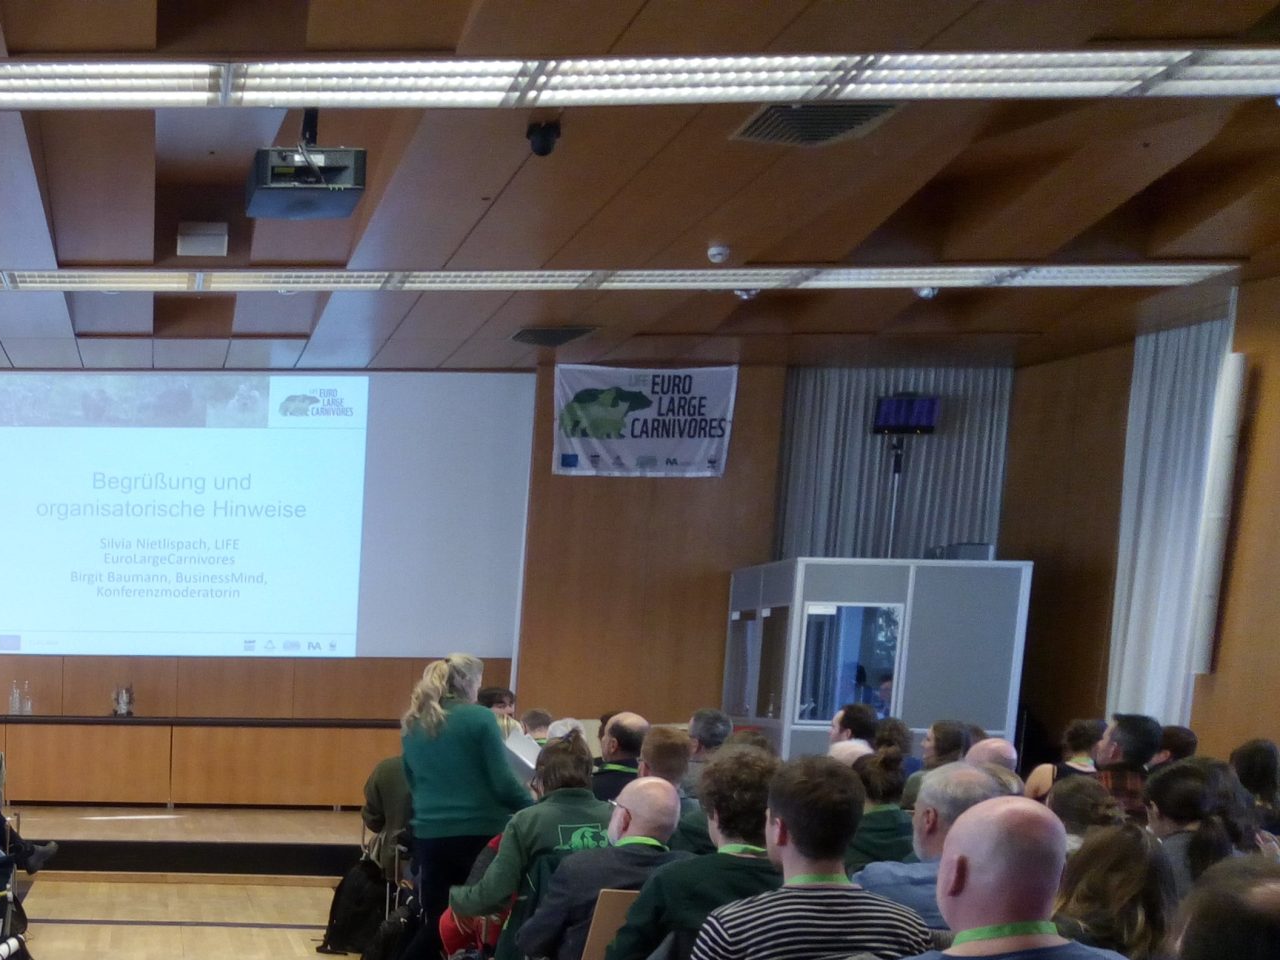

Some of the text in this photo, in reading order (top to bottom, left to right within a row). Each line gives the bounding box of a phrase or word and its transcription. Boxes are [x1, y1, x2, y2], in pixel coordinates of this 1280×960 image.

[651, 374, 693, 395] EURO
[320, 388, 338, 397] EURO
[322, 398, 344, 407] LARGE
[657, 396, 707, 417] LARGE
[311, 407, 354, 416] CARNIVORES
[630, 418, 726, 438] CARNIVORES
[92, 472, 252, 494] Begrüßung und
[36, 500, 307, 520] organisatorische Hinweise
[99, 538, 240, 553] Silvia Nietlispach, LIFE
[104, 553, 236, 567] EuroLargeCarnivores
[70, 571, 268, 586] Birgit Baumann, BusinessMind,
[96, 587, 241, 599] Konferenzmoderatorin
